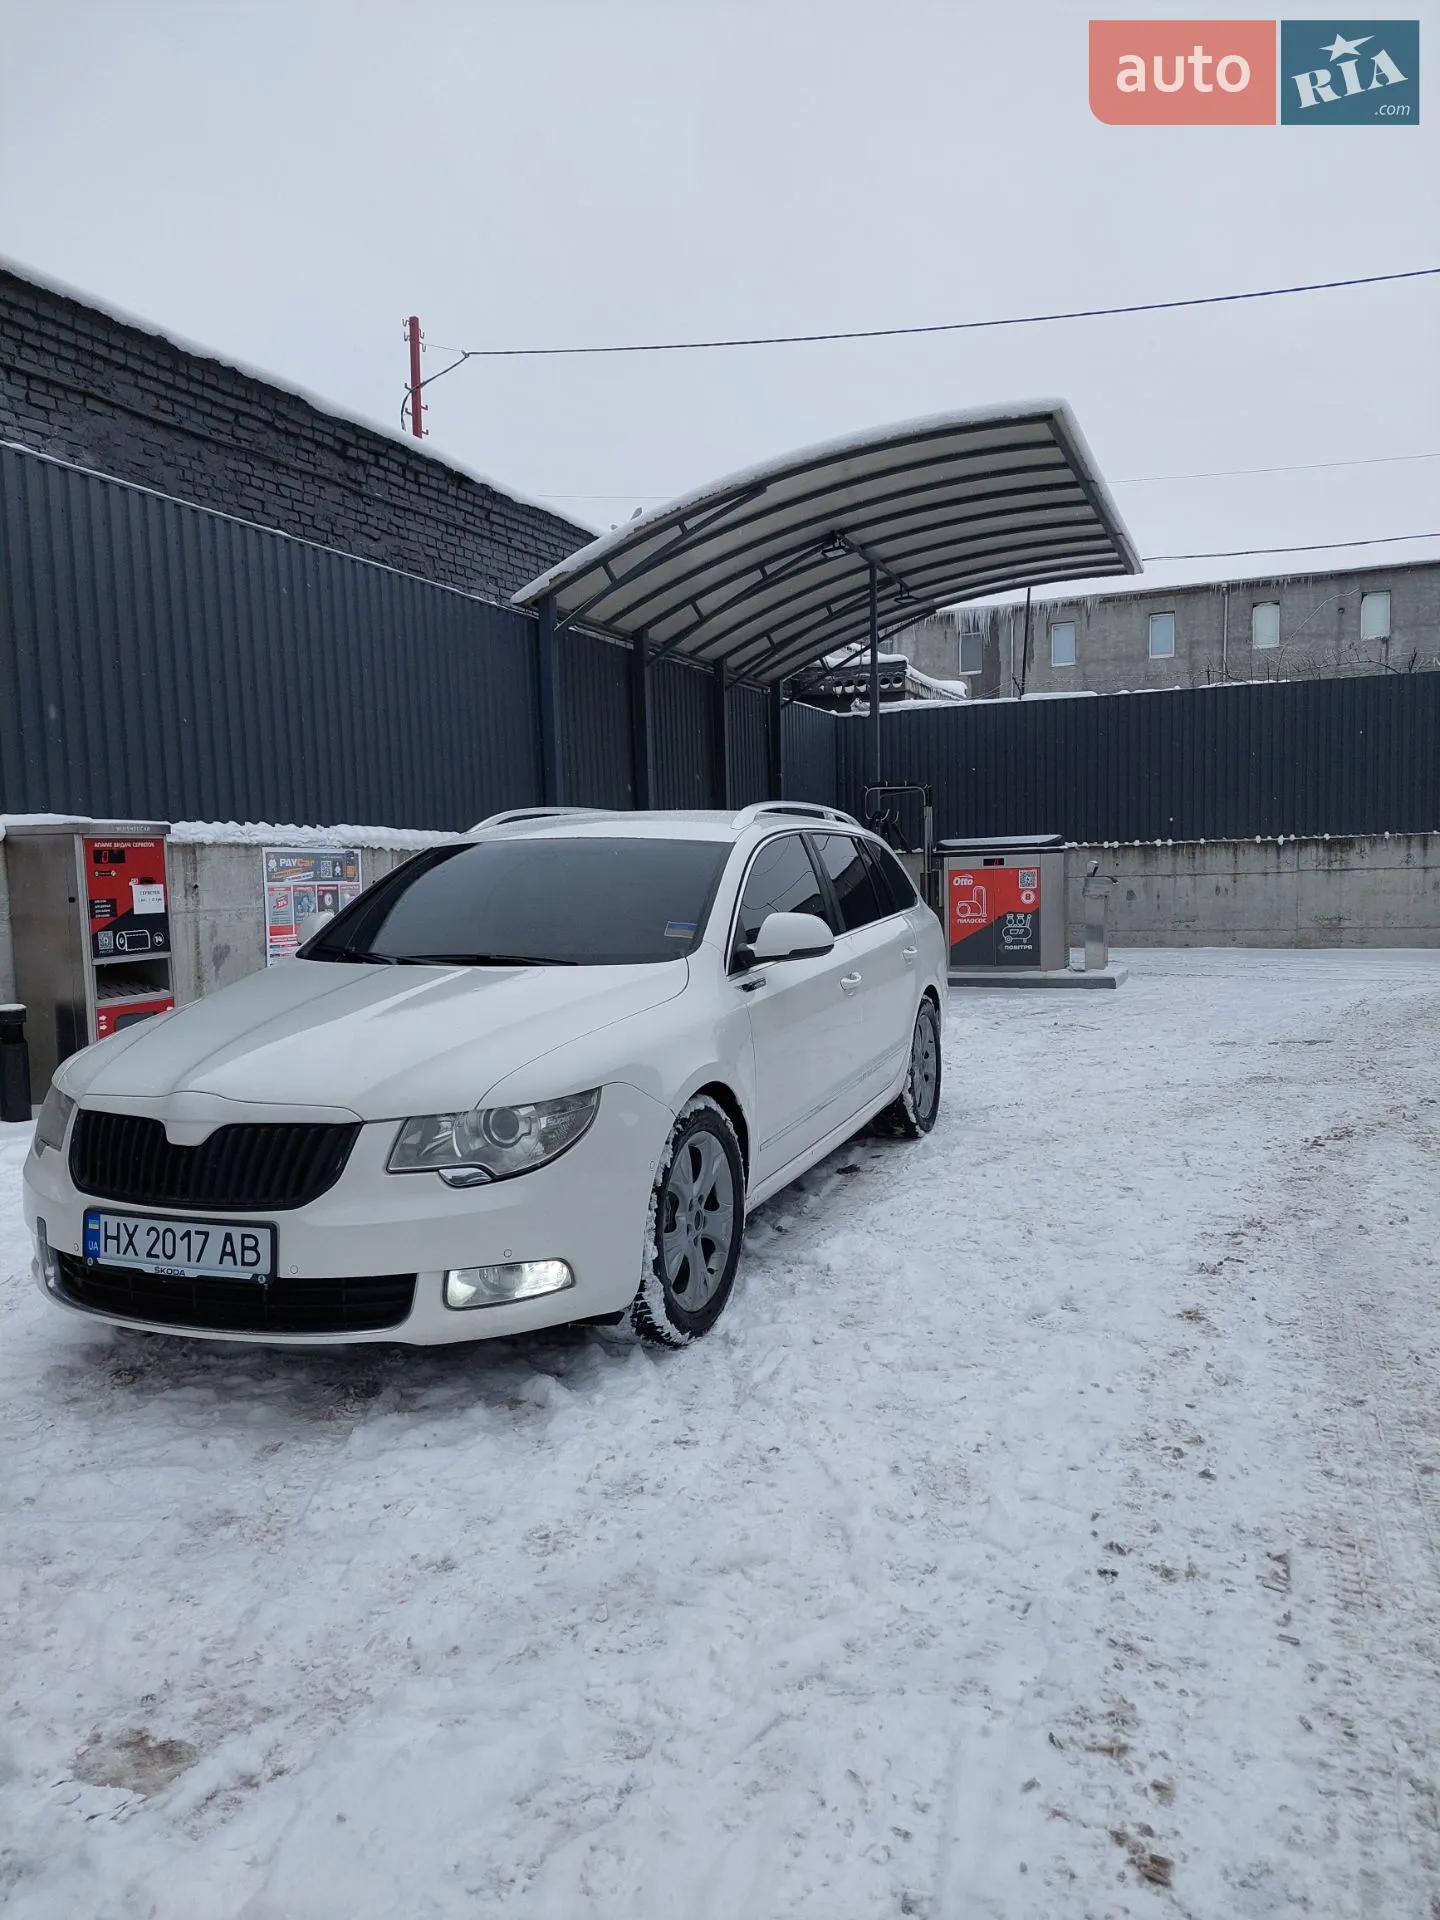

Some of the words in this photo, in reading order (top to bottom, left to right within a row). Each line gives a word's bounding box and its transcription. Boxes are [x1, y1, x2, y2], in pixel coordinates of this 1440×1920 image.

[953, 876, 974, 886] Otto
[88, 1239, 99, 1251] UA
[103, 1220, 139, 1257] HX
[145, 1226, 210, 1264] 2017
[218, 1232, 261, 1267] AB
